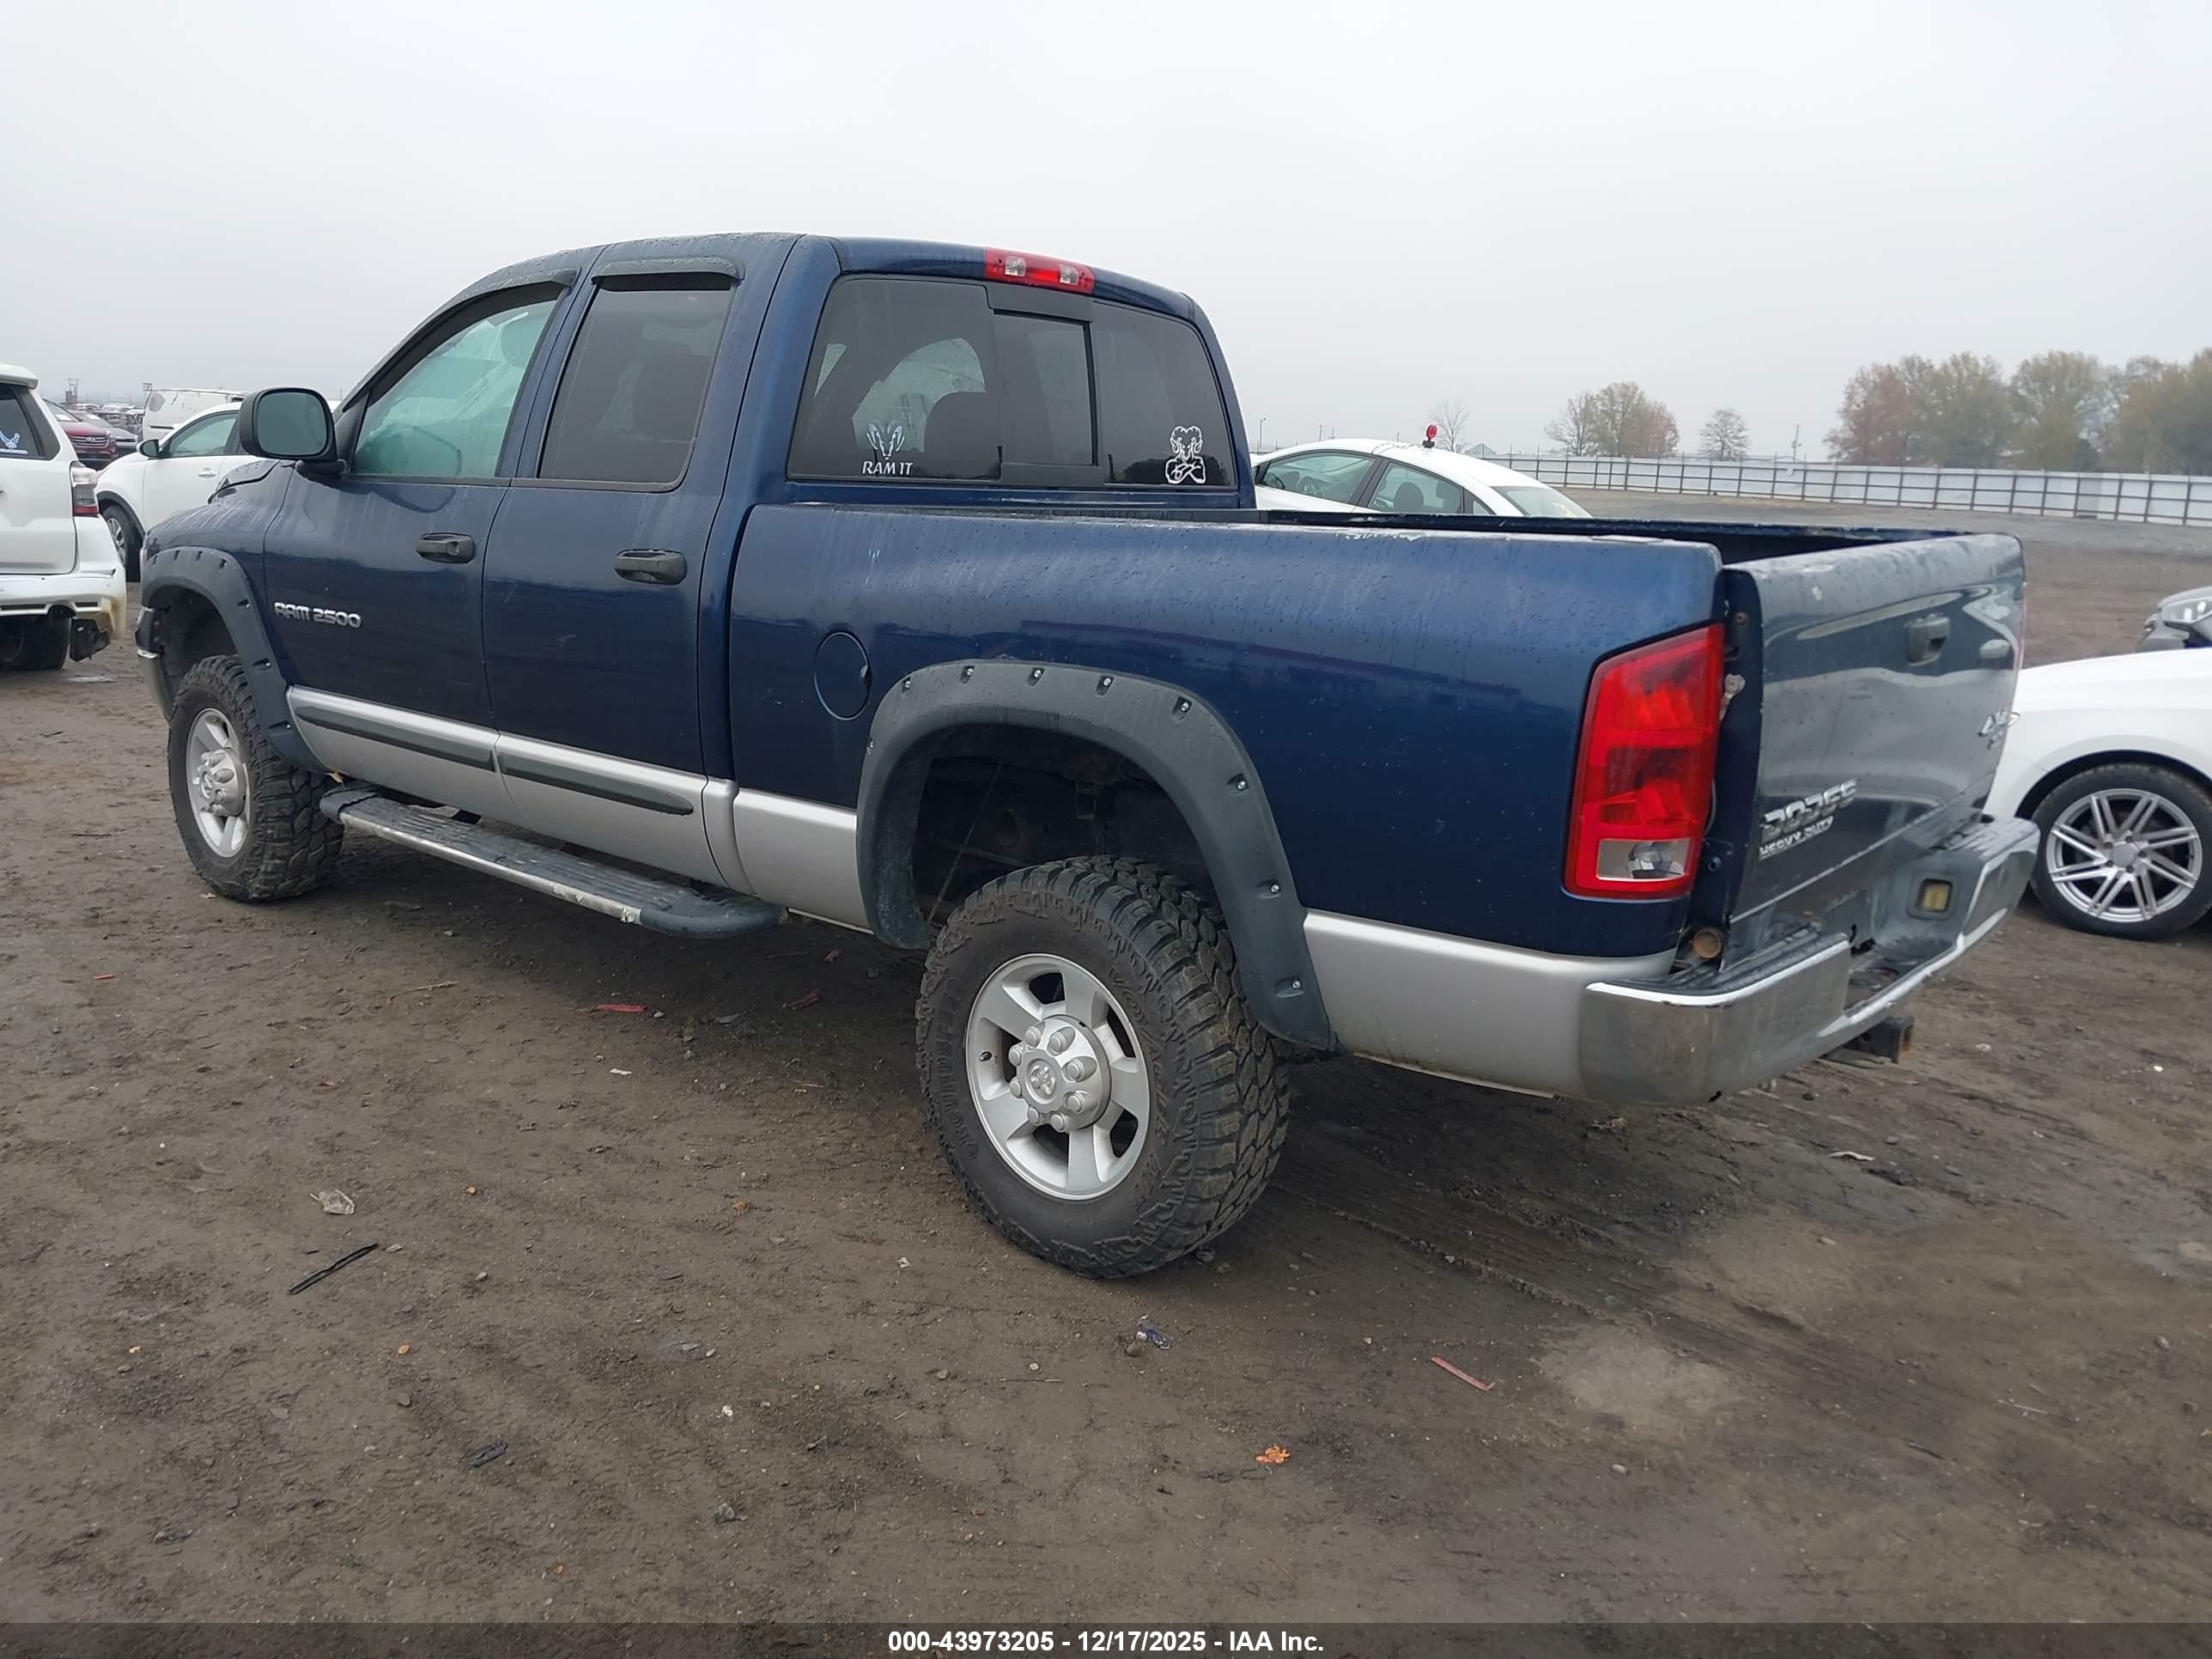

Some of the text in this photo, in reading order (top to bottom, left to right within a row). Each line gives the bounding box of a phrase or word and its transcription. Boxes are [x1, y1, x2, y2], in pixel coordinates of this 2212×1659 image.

[861, 460, 914, 476] RAM IT
[274, 601, 362, 629] RAM 2500
